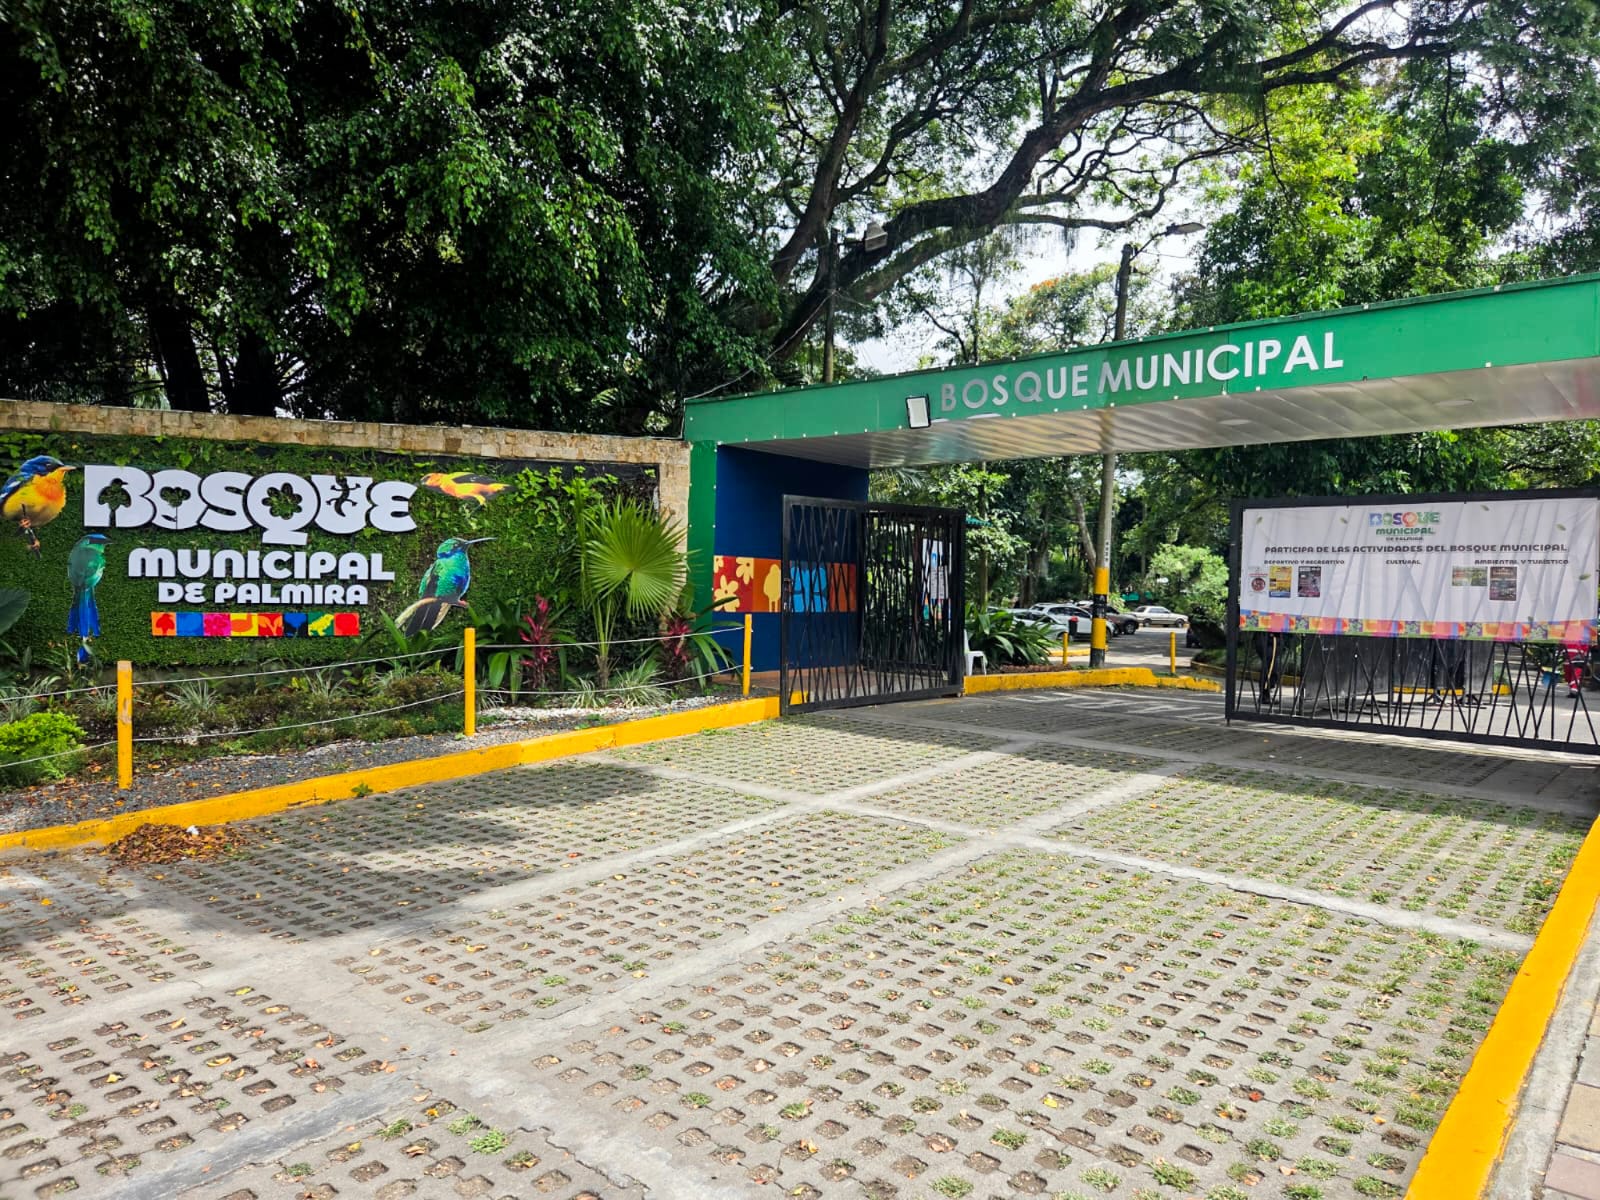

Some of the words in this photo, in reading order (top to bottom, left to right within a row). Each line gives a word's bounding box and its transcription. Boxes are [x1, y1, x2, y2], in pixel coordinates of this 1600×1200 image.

[941, 364, 1089, 412] BOSQUE
[1098, 331, 1345, 394] MUNICIPAL
[84, 464, 418, 546] BOSQUE
[1369, 511, 1441, 527] BOSQUE
[1375, 527, 1436, 535] MUNICIPAL
[1332, 545, 1350, 553] LAS
[1353, 545, 1423, 553] ACTIVIDADES
[1426, 545, 1447, 553] DEL
[1450, 544, 1497, 553] BOSQUE
[1500, 544, 1568, 552] MUNICIPAL
[128, 547, 396, 582] MUNICIPAL
[158, 582, 207, 604] DE
[214, 582, 369, 606] PALMIRA
